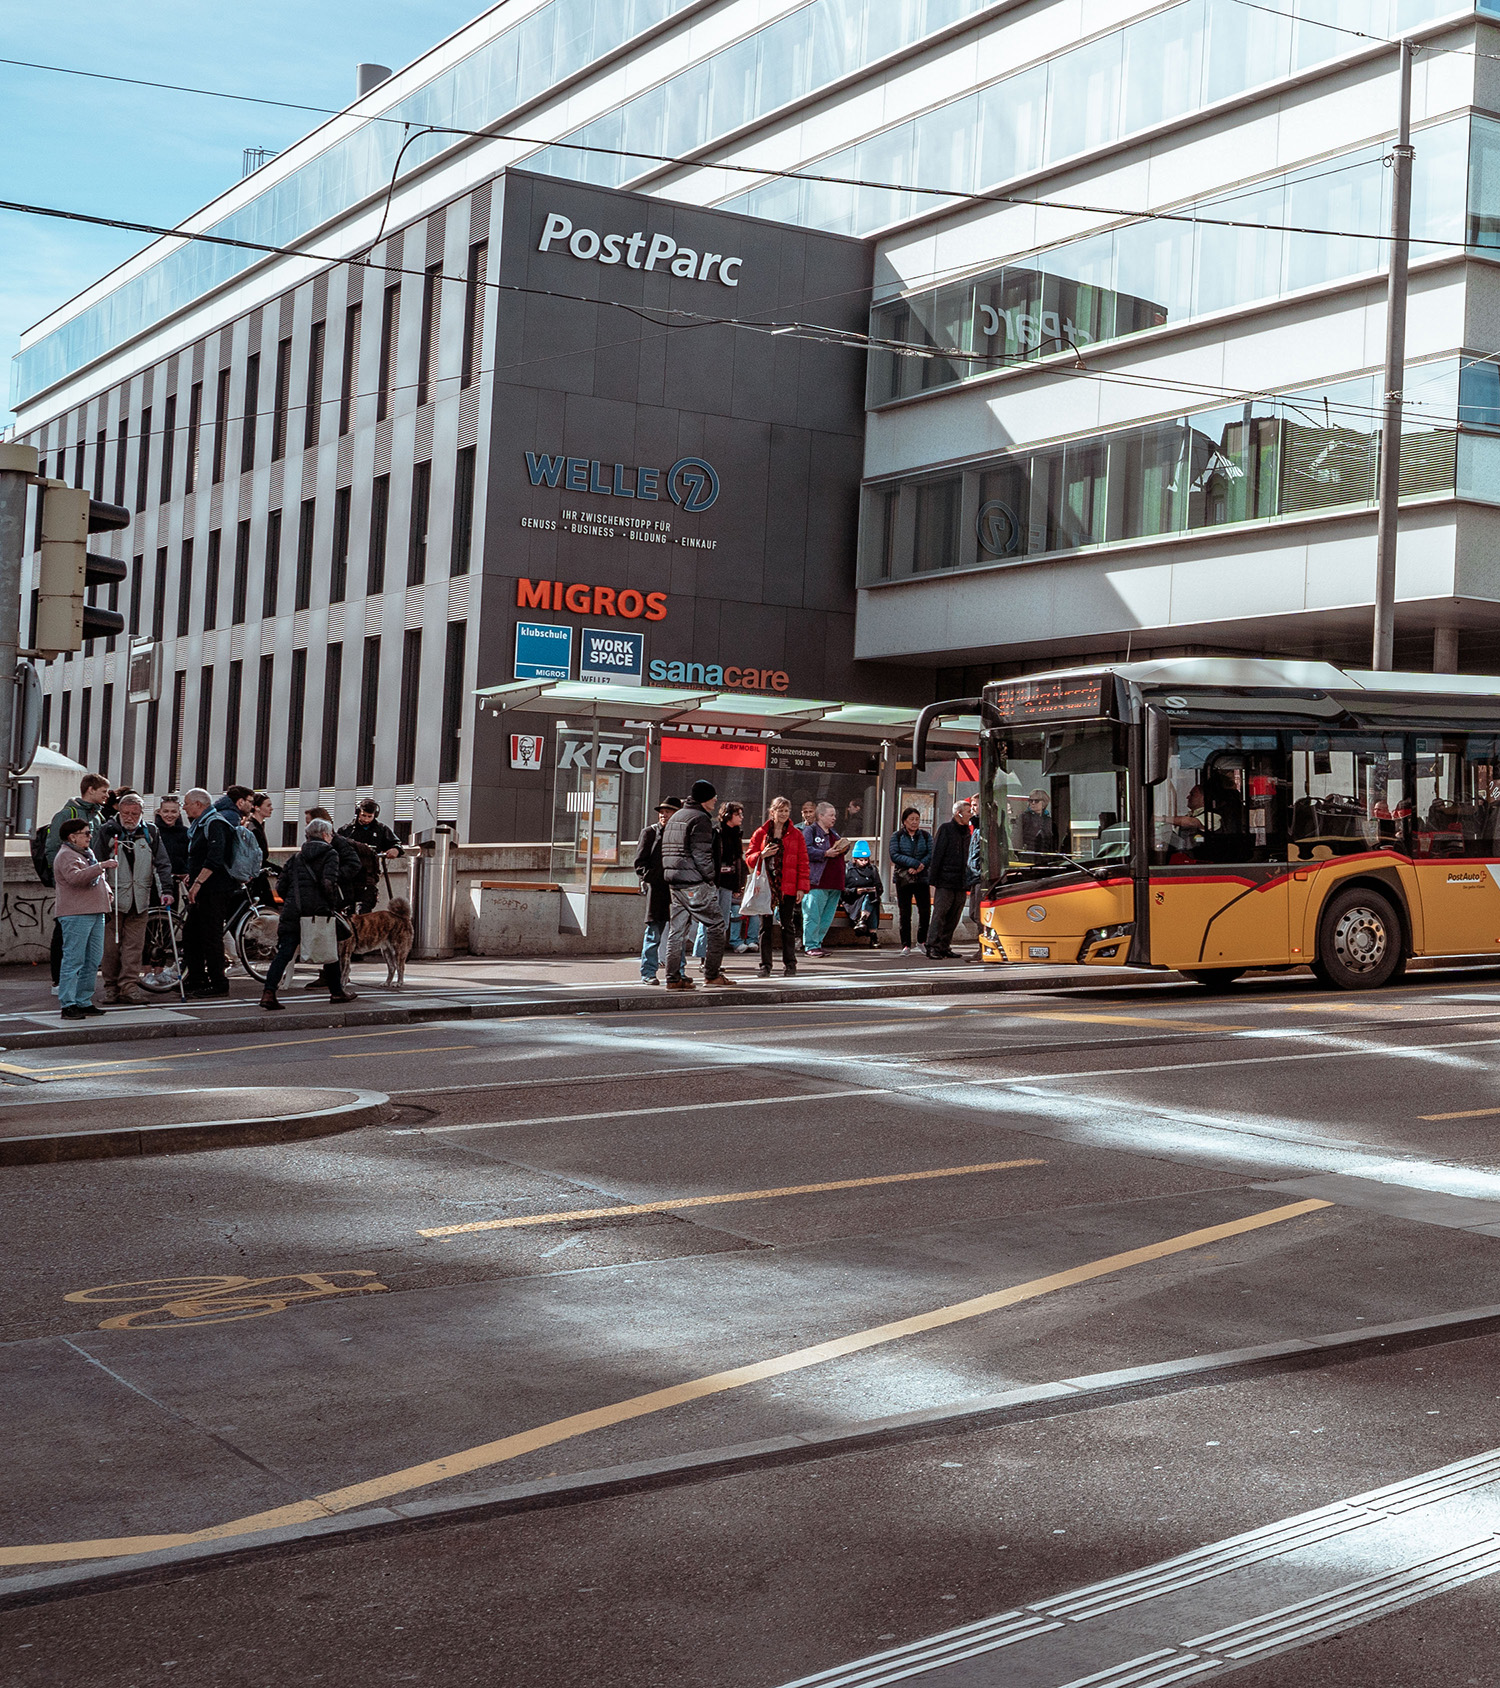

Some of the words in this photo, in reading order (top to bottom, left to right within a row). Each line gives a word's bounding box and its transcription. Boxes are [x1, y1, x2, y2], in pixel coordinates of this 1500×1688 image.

[538, 212, 744, 287] PostParc
[525, 451, 660, 501] WELLE
[562, 509, 578, 521] IHR
[580, 511, 652, 530] ZWISCHENSTOPP
[654, 519, 671, 532] FÜR
[521, 517, 557, 531] GENUSS
[571, 523, 615, 538] BUSINESS
[629, 530, 667, 544] BILDUNG
[681, 536, 718, 551] EINKAUF
[517, 577, 668, 621] MIGROS
[520, 626, 568, 640] klubschule
[590, 637, 634, 654] WORK
[589, 651, 634, 667] SPACE
[535, 668, 566, 678] MIGROS
[648, 659, 790, 692] sanacare
[557, 740, 647, 774] KFC
[770, 746, 820, 758] Schanzenstrasse
[1447, 872, 1480, 881] PostAuto
